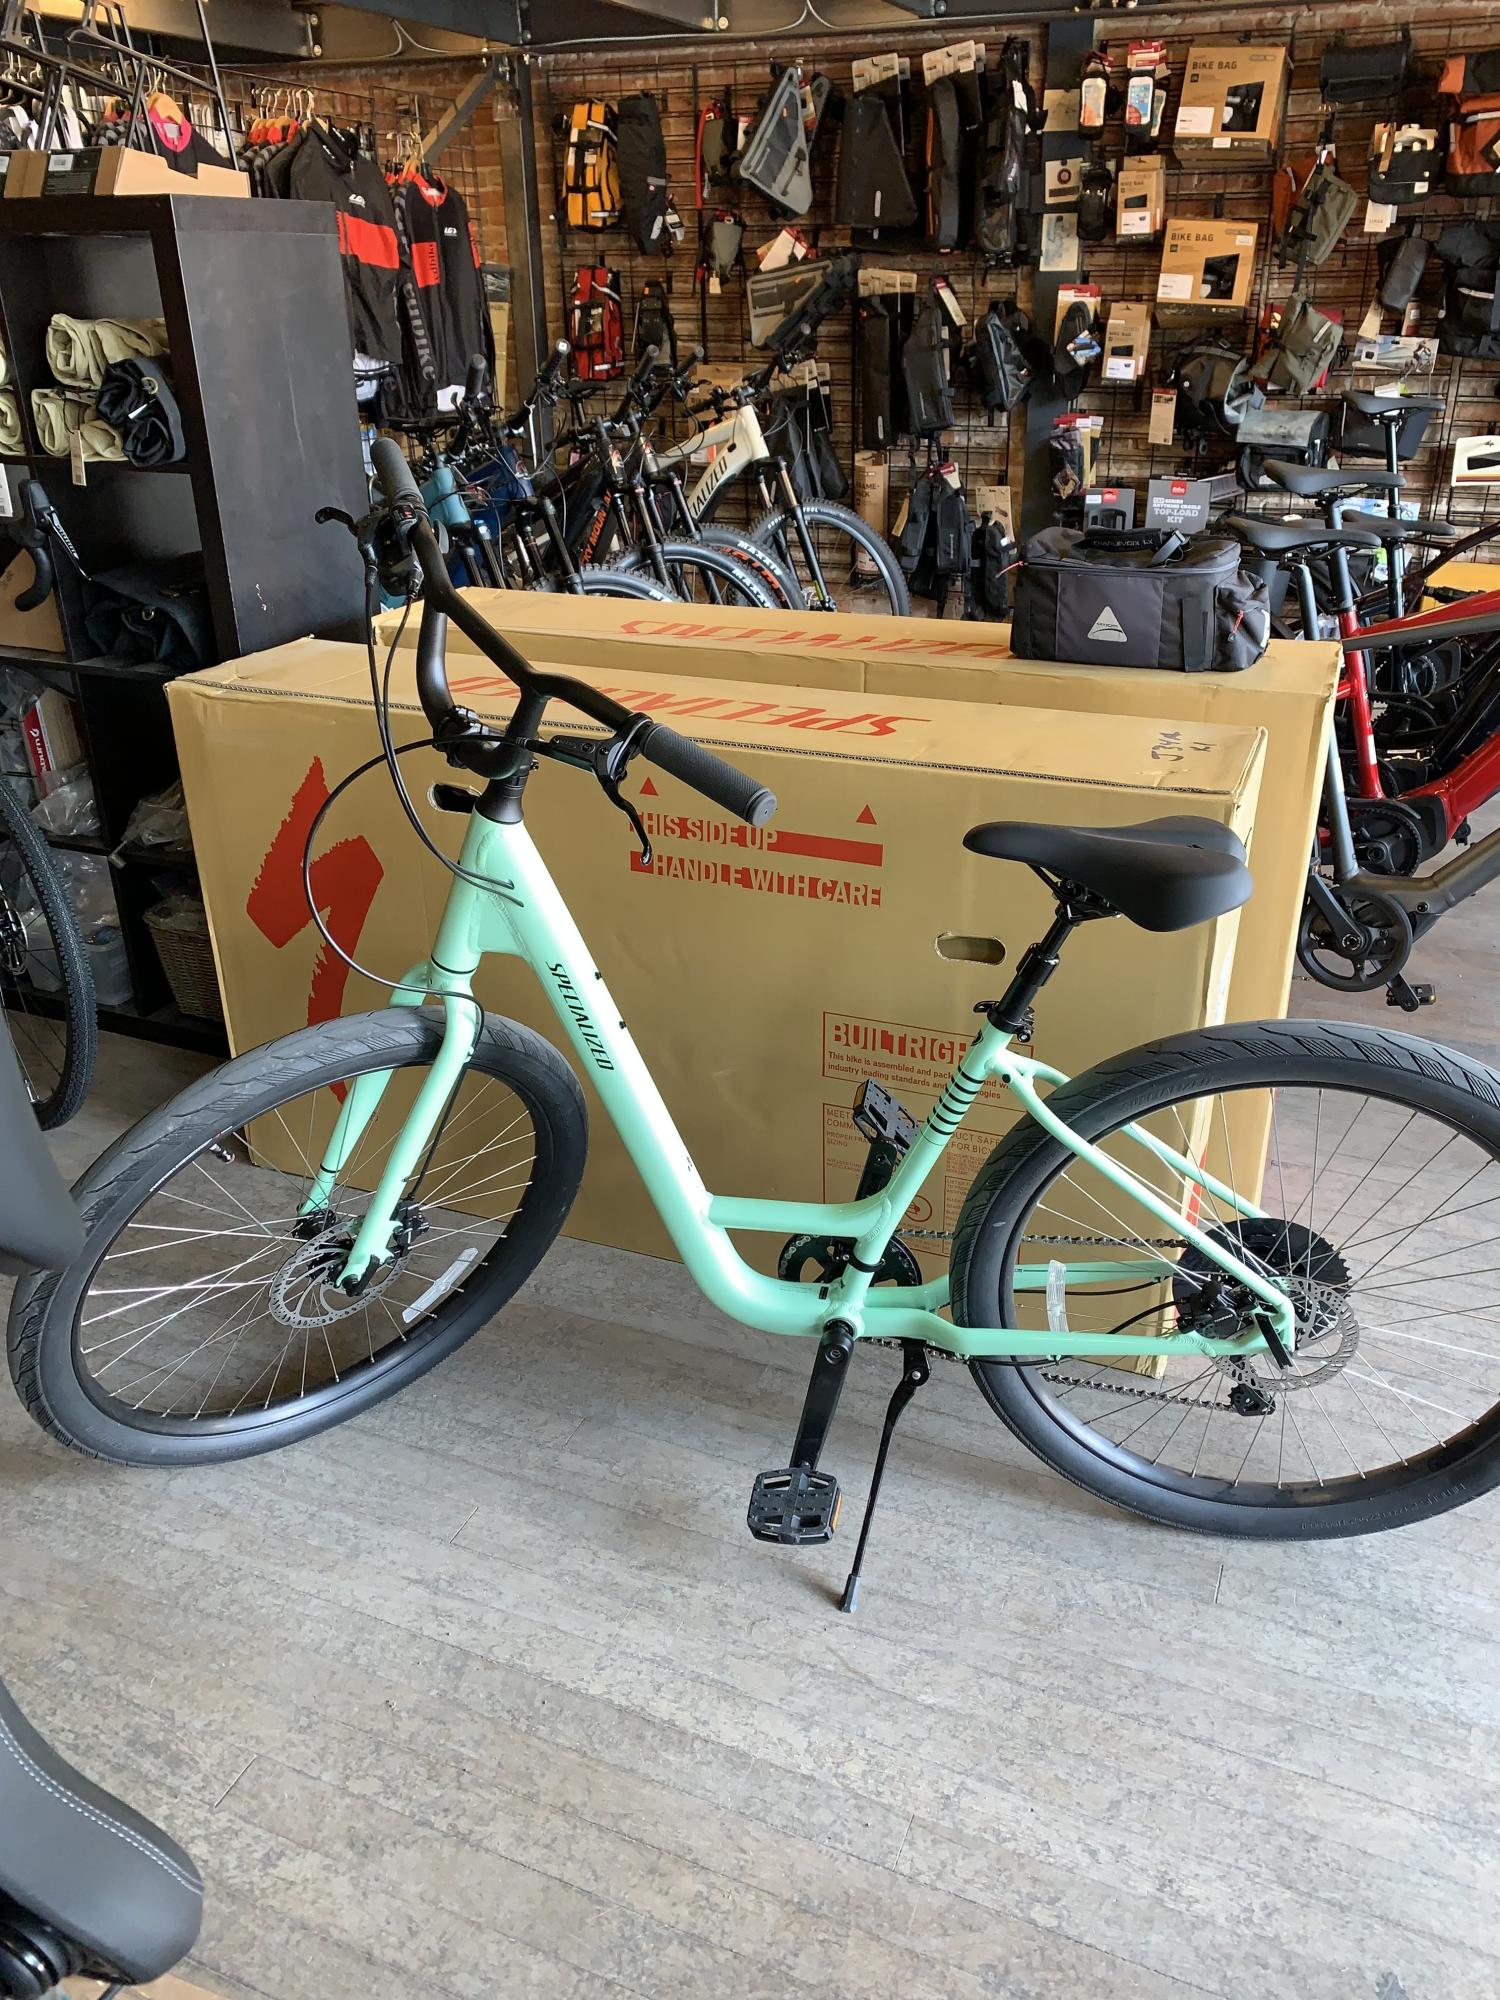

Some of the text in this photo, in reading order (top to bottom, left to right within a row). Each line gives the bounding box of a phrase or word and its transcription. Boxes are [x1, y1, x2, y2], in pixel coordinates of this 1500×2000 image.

[1192, 60, 1237, 70] BIKE BAG
[1170, 232, 1214, 242] BIKE BAG
[690, 455, 728, 517] IALIZED
[1153, 508, 1199, 517] TOP-LOAD
[1166, 515, 1184, 524] KIT
[737, 539, 783, 577] MAXXIS
[731, 568, 772, 609] MAXXI
[620, 620, 1010, 660] SPECIALIZE
[448, 676, 932, 737] SPECIALED
[686, 816, 740, 846] SIDE
[745, 824, 778, 850] UP
[653, 853, 881, 908] HANDLE WITH CARE
[546, 961, 614, 1071] SPECIALIZED
[832, 1023, 968, 1066] BUILTRIGH
[828, 1051, 844, 1061] This
[846, 1055, 862, 1064] bike
[864, 1058, 871, 1066] is
[873, 1062, 915, 1074] assembled
[916, 1068, 932, 1078] and
[933, 1070, 953, 1080] pack
[828, 1062, 860, 1075] industry
[861, 1067, 889, 1081] leading
[891, 1072, 930, 1087] standards
[826, 1108, 853, 1119] MEET
[950, 1141, 970, 1151] FOR
